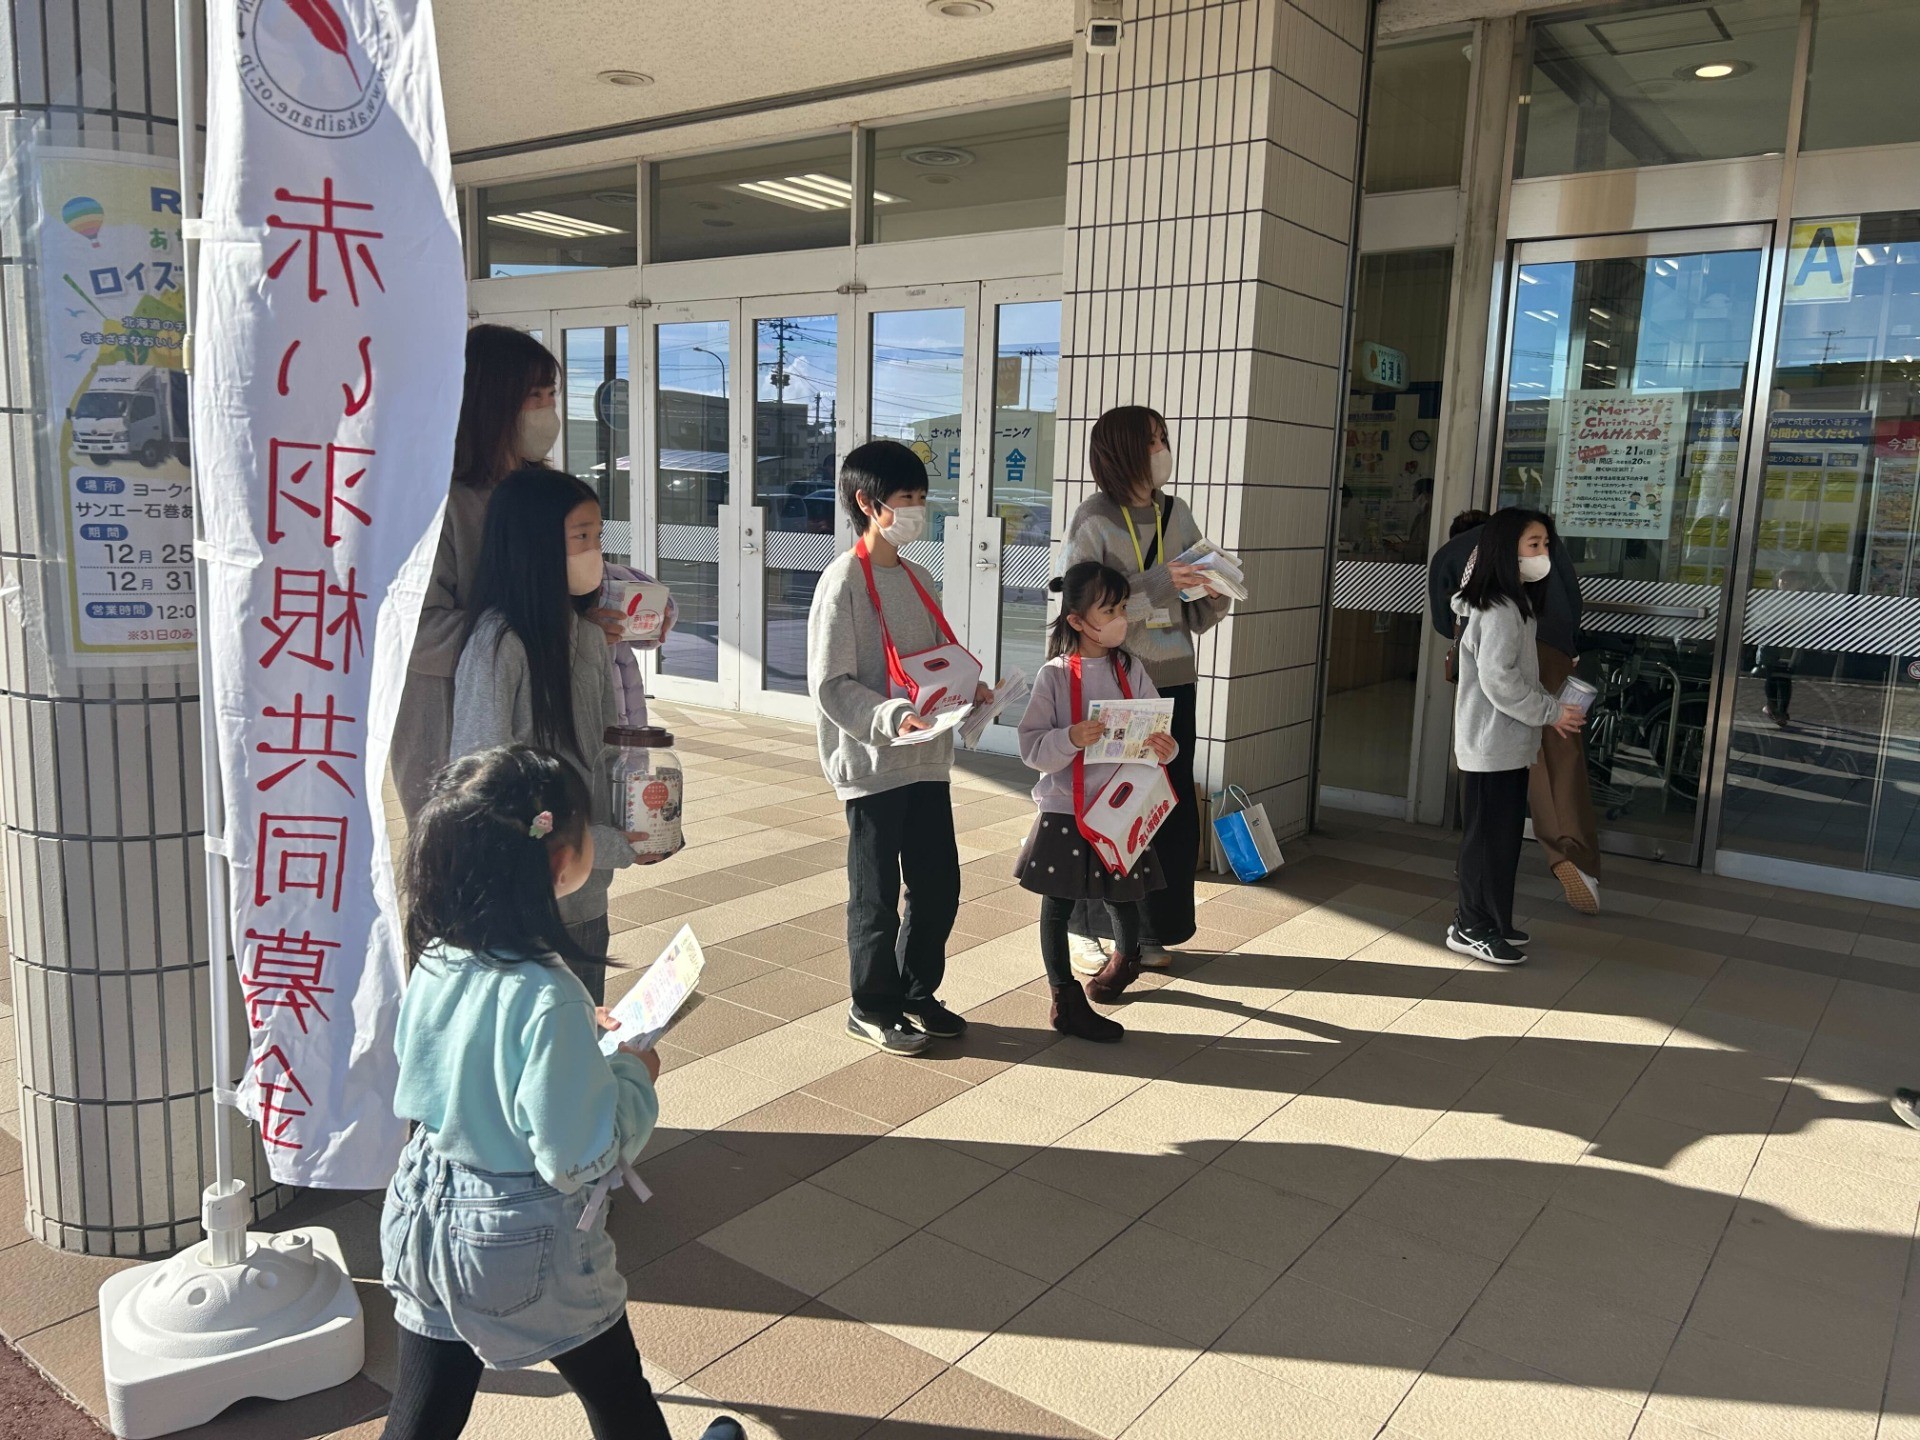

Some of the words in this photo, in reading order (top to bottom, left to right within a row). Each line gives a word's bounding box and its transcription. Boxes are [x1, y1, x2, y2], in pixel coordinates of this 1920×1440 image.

[1794, 227, 1844, 286] A
[89, 262, 183, 295] ロイズ
[1598, 406, 1650, 416] Merry
[1584, 415, 1658, 428] Christmas!
[1578, 428, 1662, 440] じゃんけん大会
[1888, 438, 1920, 451] 今週
[85, 480, 117, 493] 場所
[88, 527, 120, 538] 期間
[91, 605, 147, 616] 営業時間
